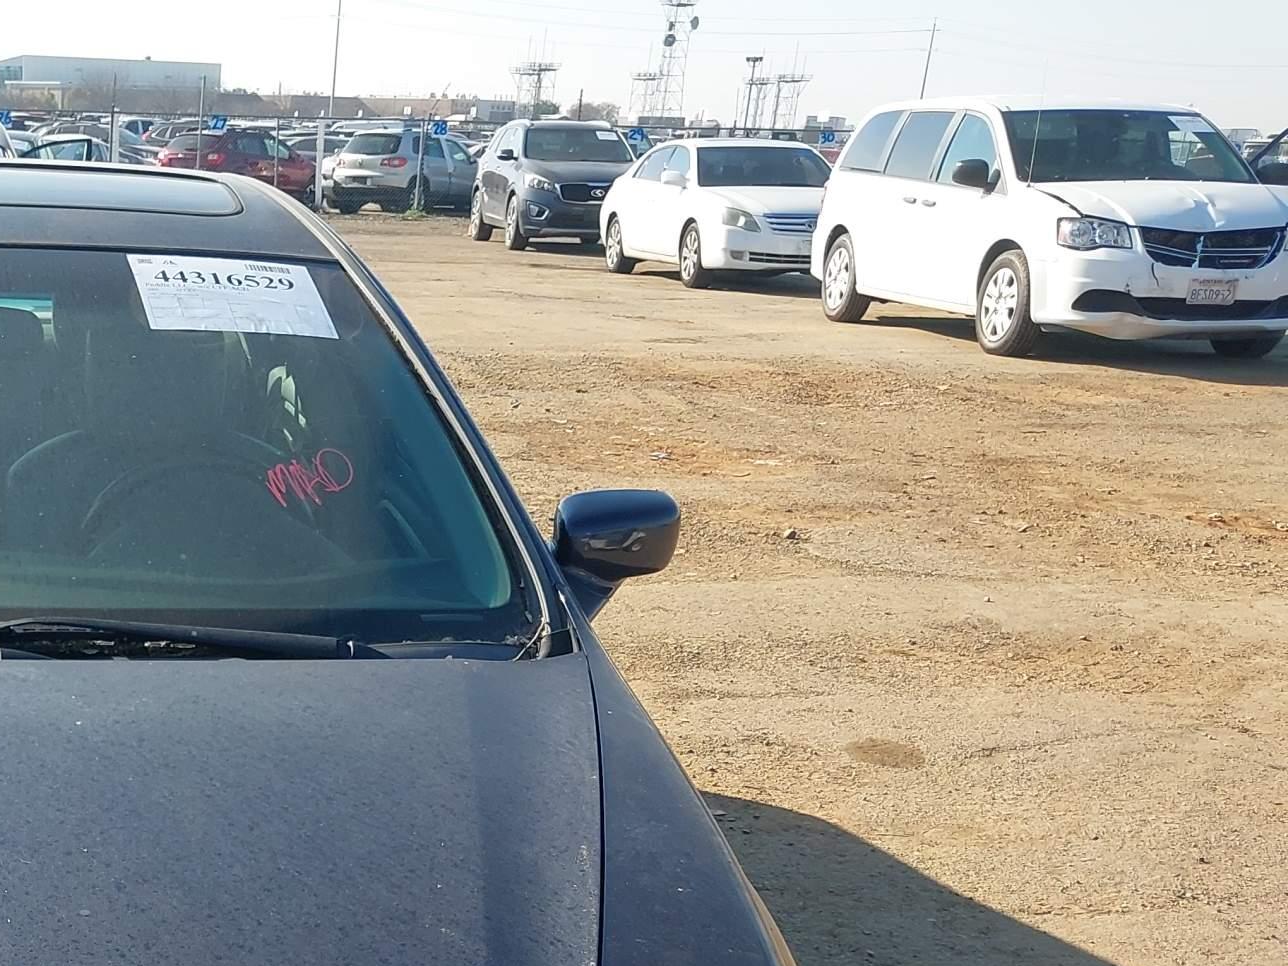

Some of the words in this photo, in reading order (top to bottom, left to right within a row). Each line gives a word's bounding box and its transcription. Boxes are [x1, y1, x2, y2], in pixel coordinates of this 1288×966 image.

[433, 121, 448, 135] 28
[628, 128, 644, 142] 29
[821, 132, 835, 144] 30
[154, 269, 294, 291] 44316529
